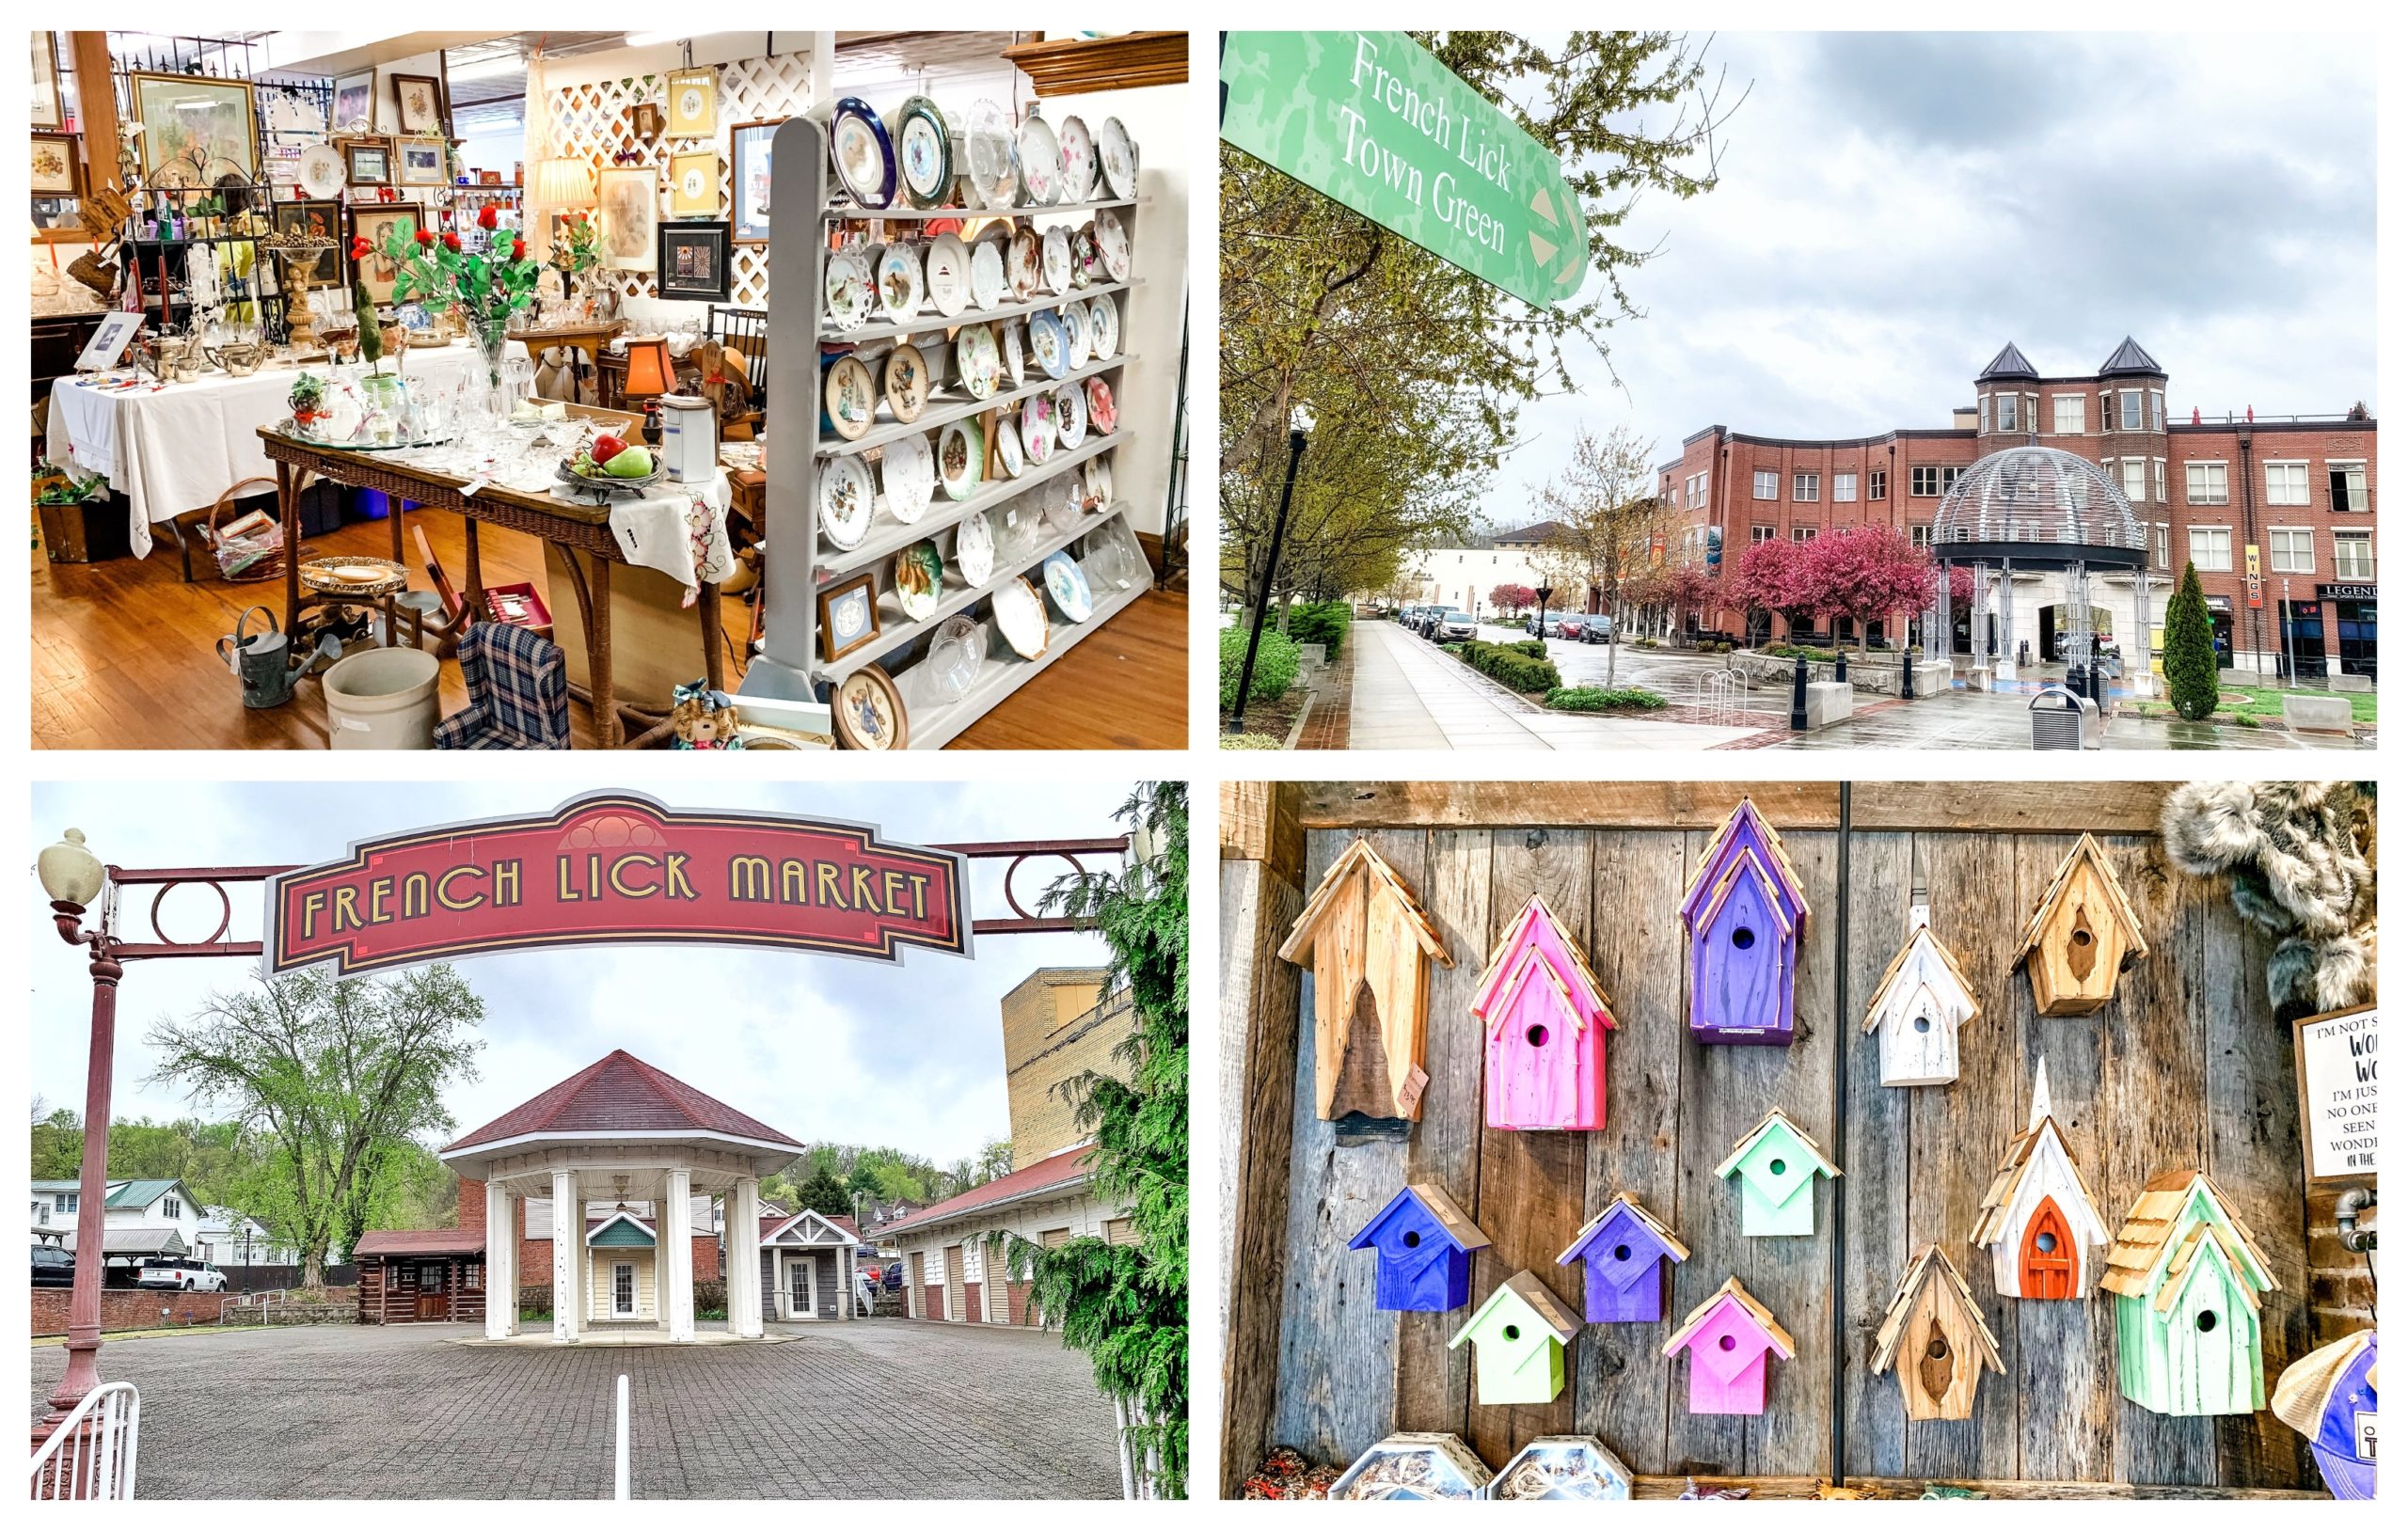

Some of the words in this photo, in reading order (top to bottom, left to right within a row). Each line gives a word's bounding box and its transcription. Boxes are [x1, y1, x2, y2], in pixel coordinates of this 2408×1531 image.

[1349, 31, 1450, 151] French
[1457, 114, 1513, 193] Lick
[1340, 105, 1422, 209] Town
[1432, 172, 1504, 256] Green
[2248, 554, 2258, 599] WINGS
[301, 858, 523, 941] FRENCH
[557, 851, 700, 902] LICK
[728, 855, 932, 922] MARKET
[2318, 1025, 2335, 1038] I'M
[2339, 1018, 2368, 1034] NOT
[2350, 1033, 2378, 1057] WO
[2333, 1089, 2352, 1101] I'M
[2327, 1107, 2347, 1119] NO
[2351, 1102, 2378, 1115] ONE
[2343, 1120, 2375, 1133] SEEN
[2347, 1154, 2356, 1167] IN
[2358, 1152, 2377, 1166] THE
